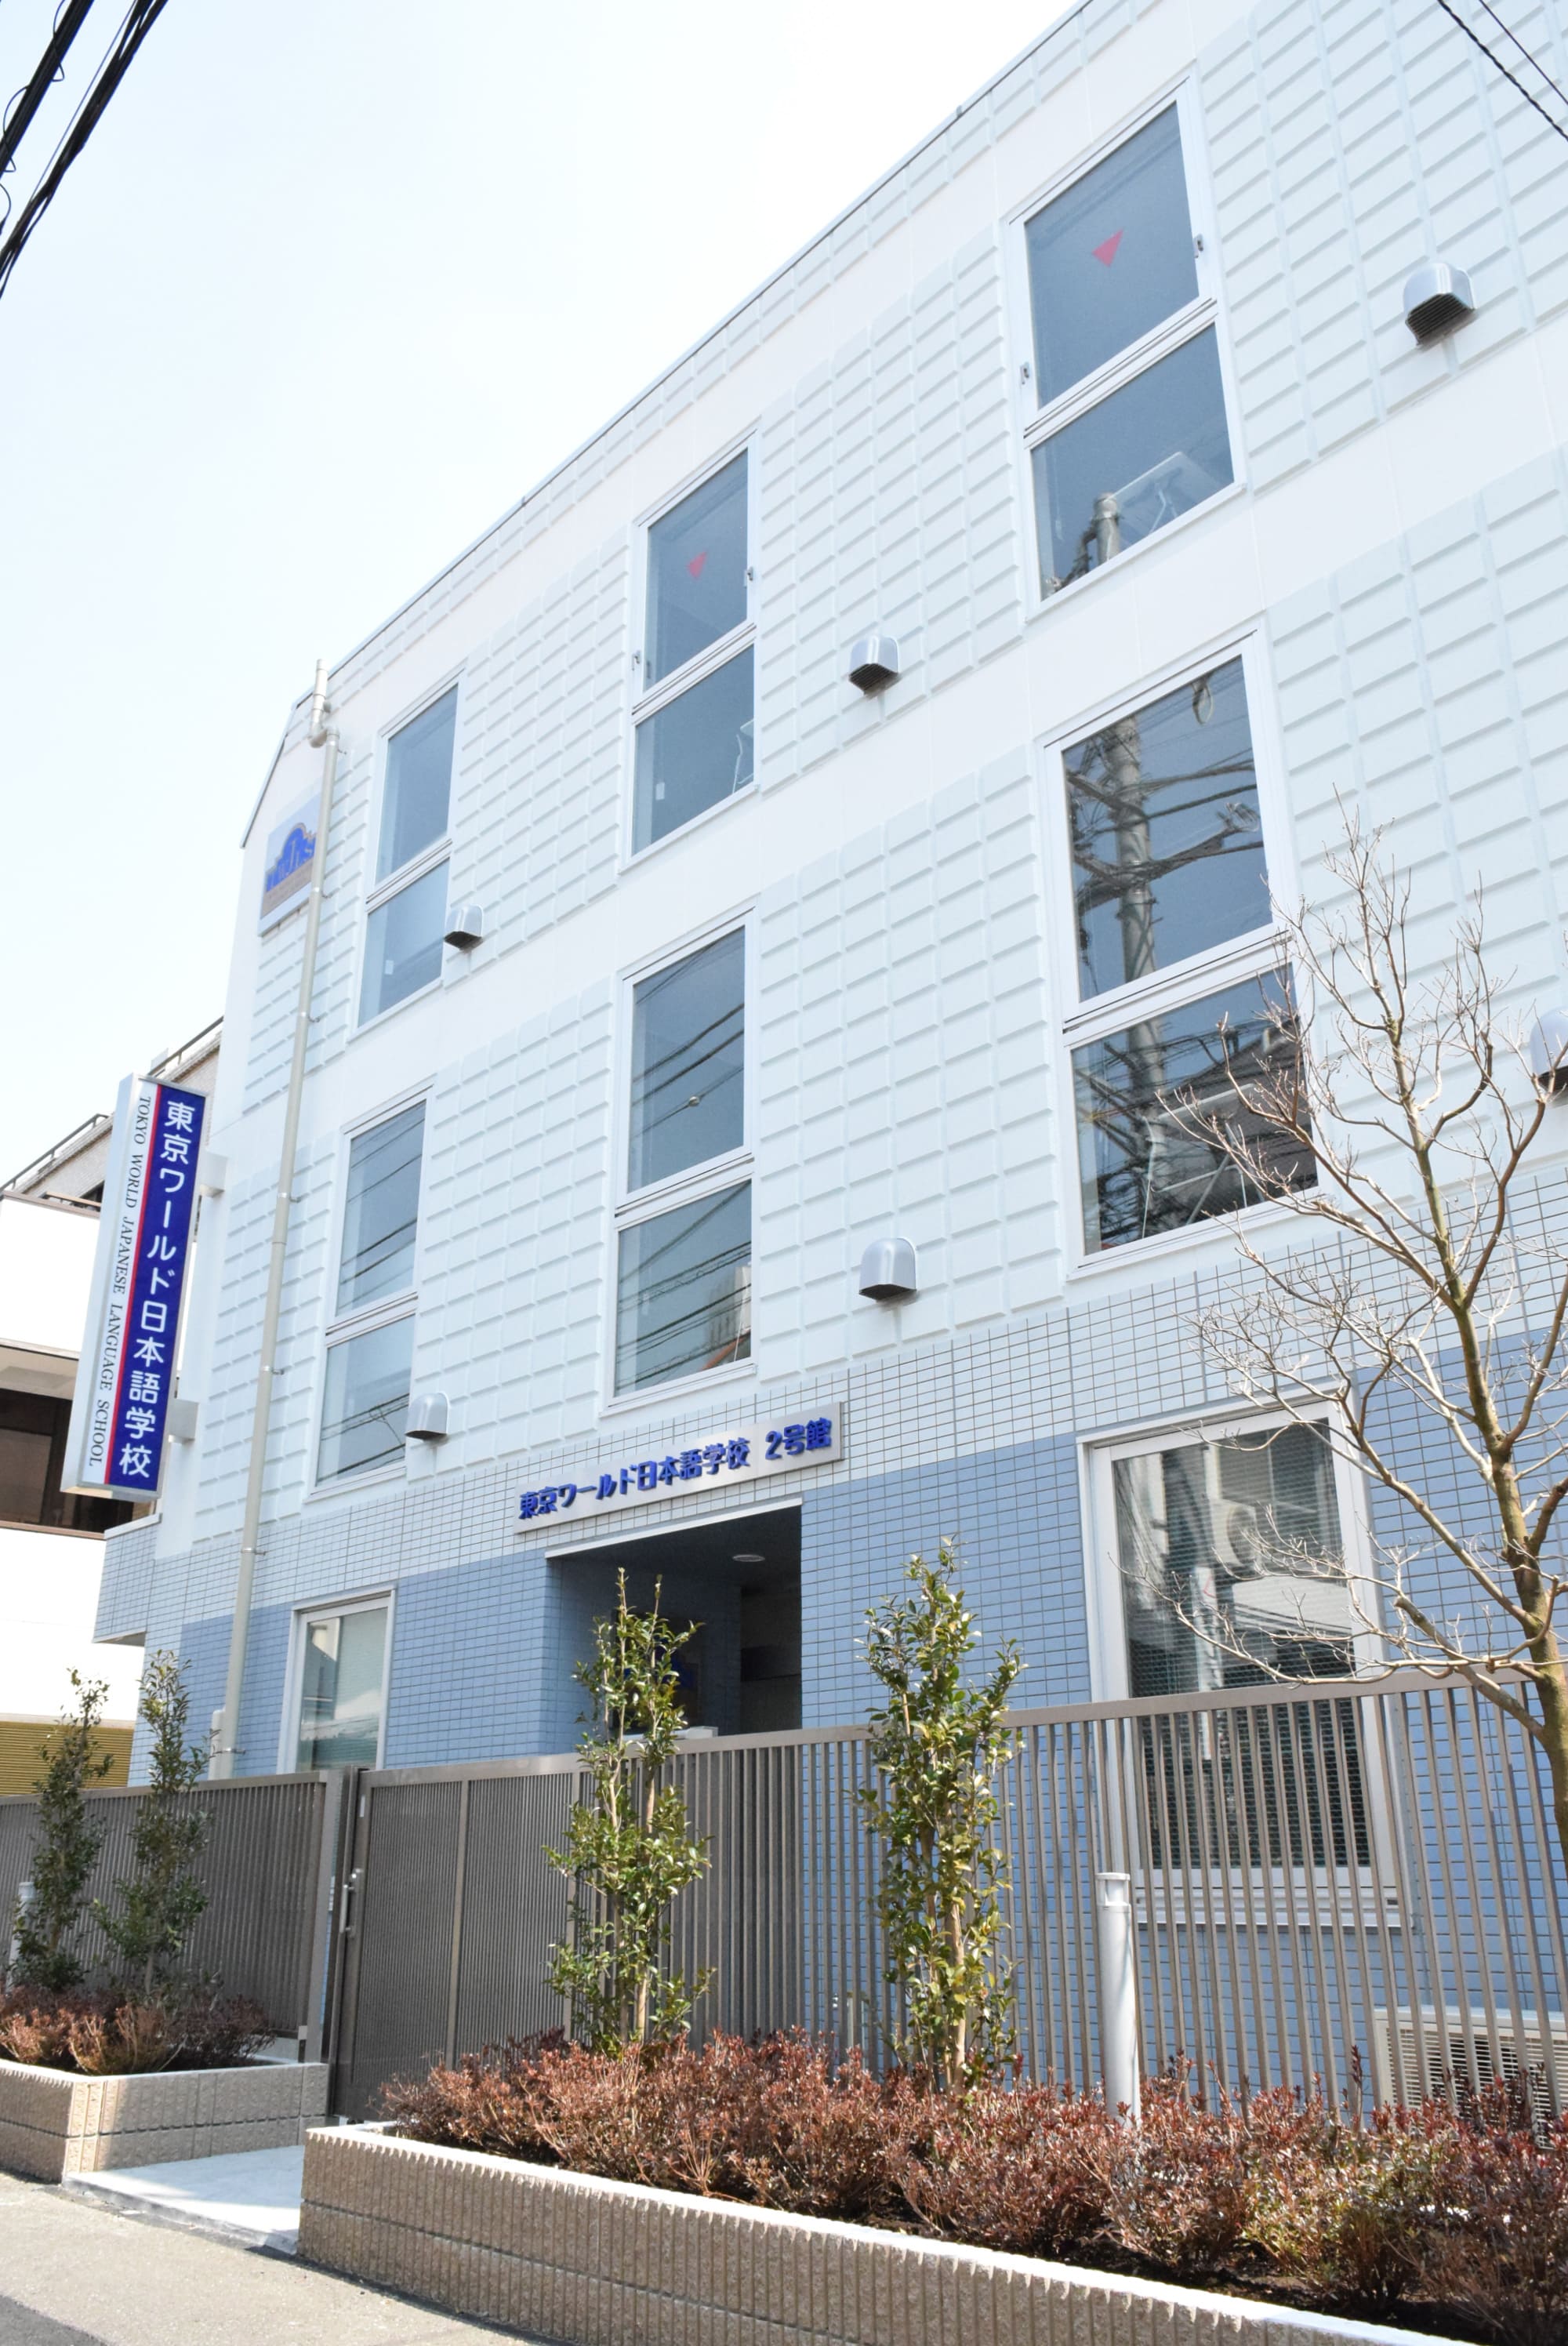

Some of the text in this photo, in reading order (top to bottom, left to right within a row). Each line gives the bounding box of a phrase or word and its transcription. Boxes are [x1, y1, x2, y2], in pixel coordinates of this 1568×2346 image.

[89, 1096, 152, 1468] TOKYO WORLD JAPANESE LANGUAGE SCHOOL
[118, 1101, 196, 1478] 東京ワールド日本語学校
[518, 1416, 833, 1520] 東京ワールド日本語学校 2号館
